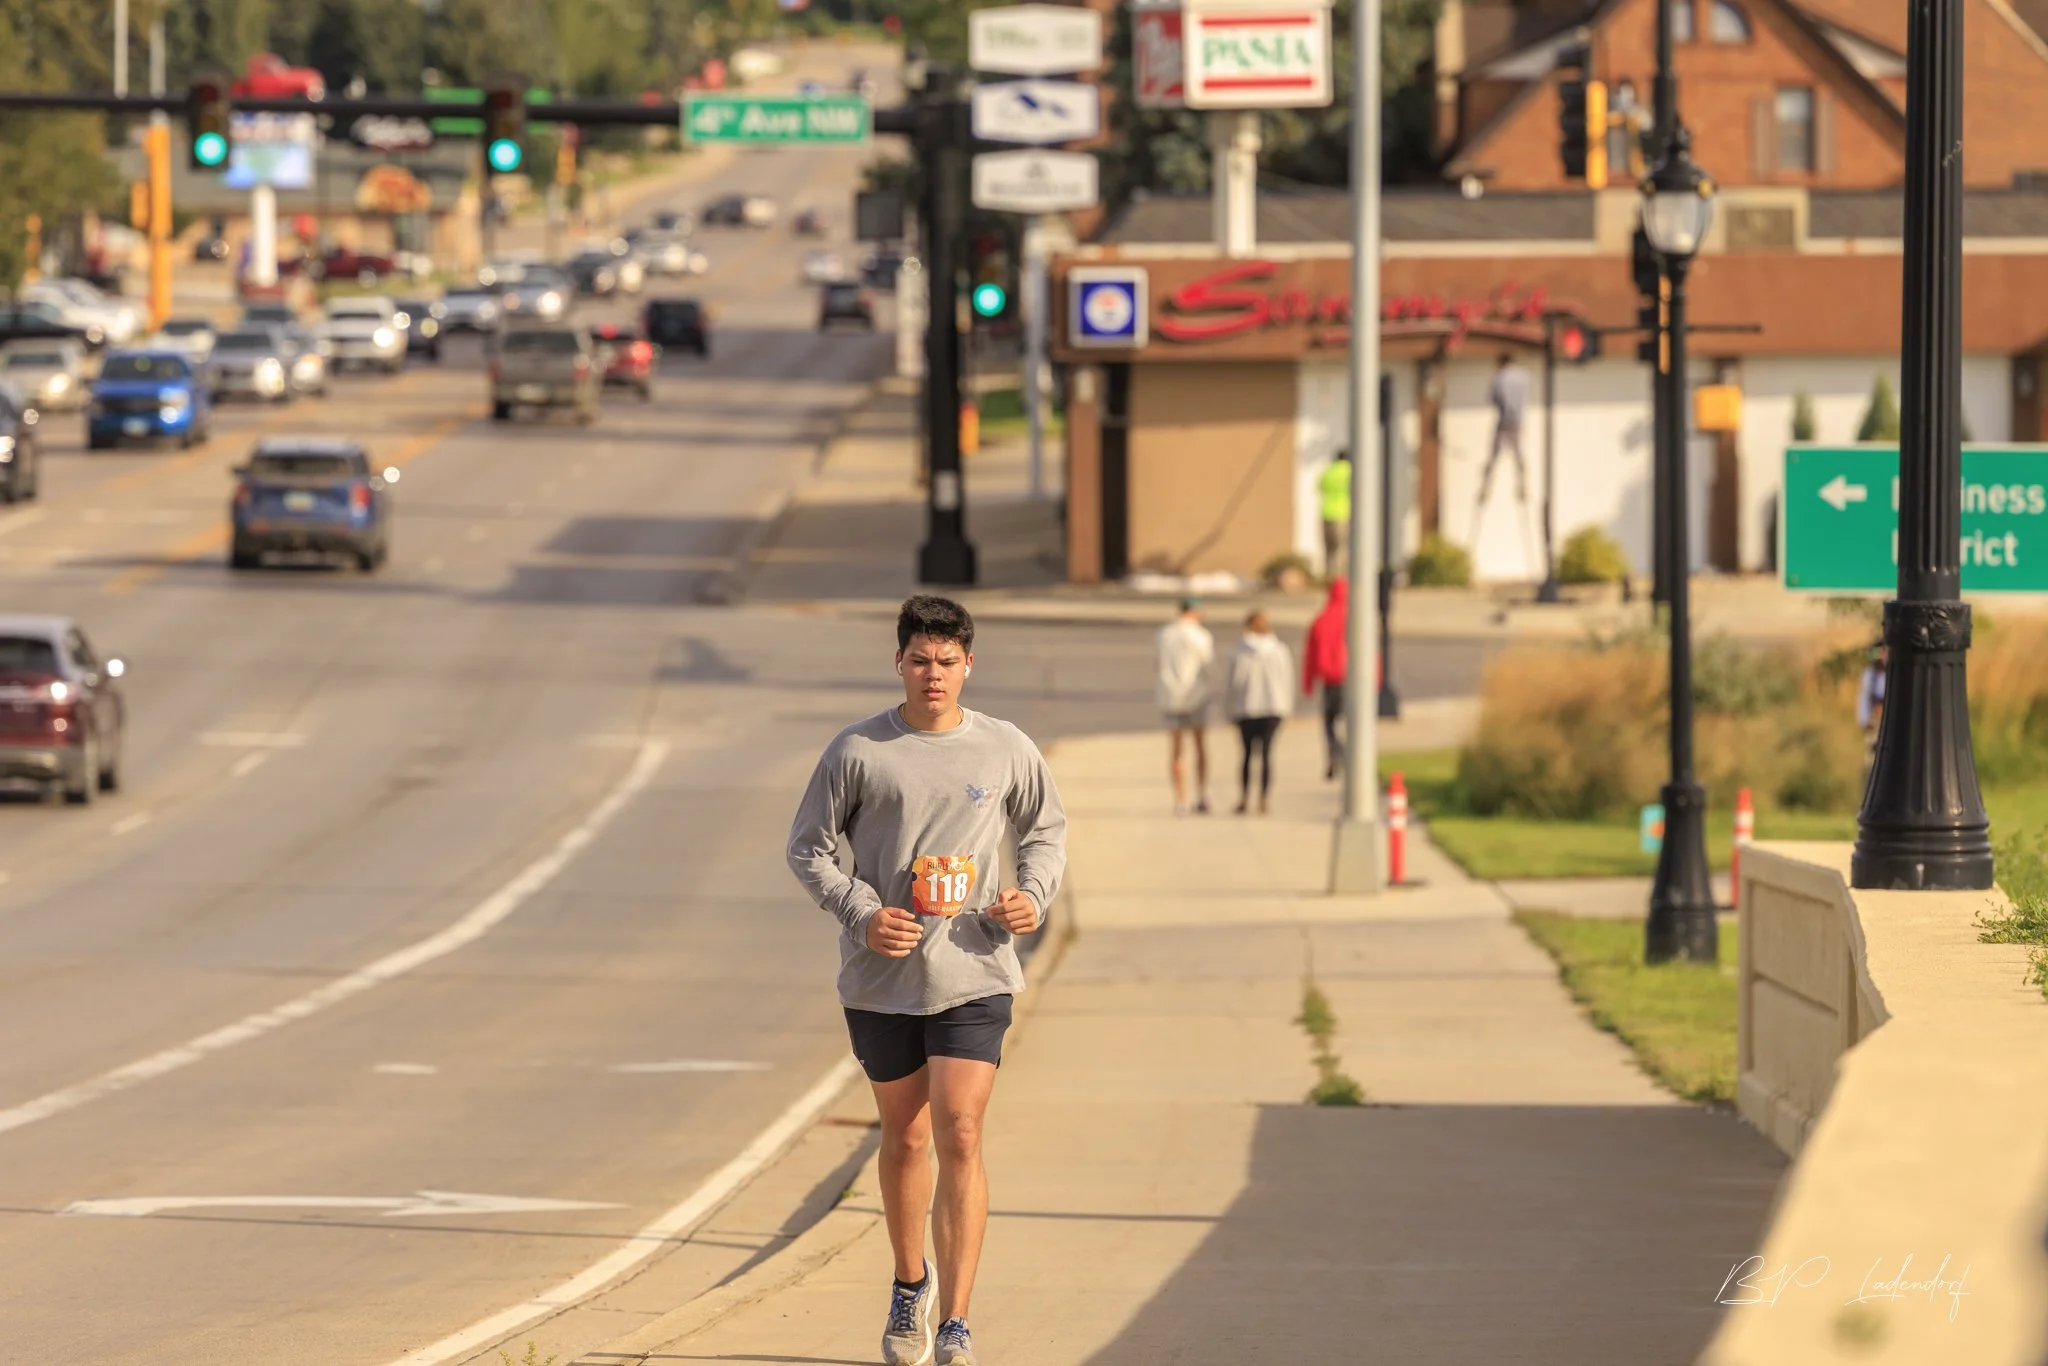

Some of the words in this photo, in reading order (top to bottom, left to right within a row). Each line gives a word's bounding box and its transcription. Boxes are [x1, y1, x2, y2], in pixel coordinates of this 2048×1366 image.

[1202, 33, 1312, 68] PASTA
[740, 104, 801, 134] Ave
[806, 106, 860, 134] NW
[1891, 475, 2047, 514] iness
[1891, 528, 2020, 567] rict
[926, 872, 968, 903] 118
